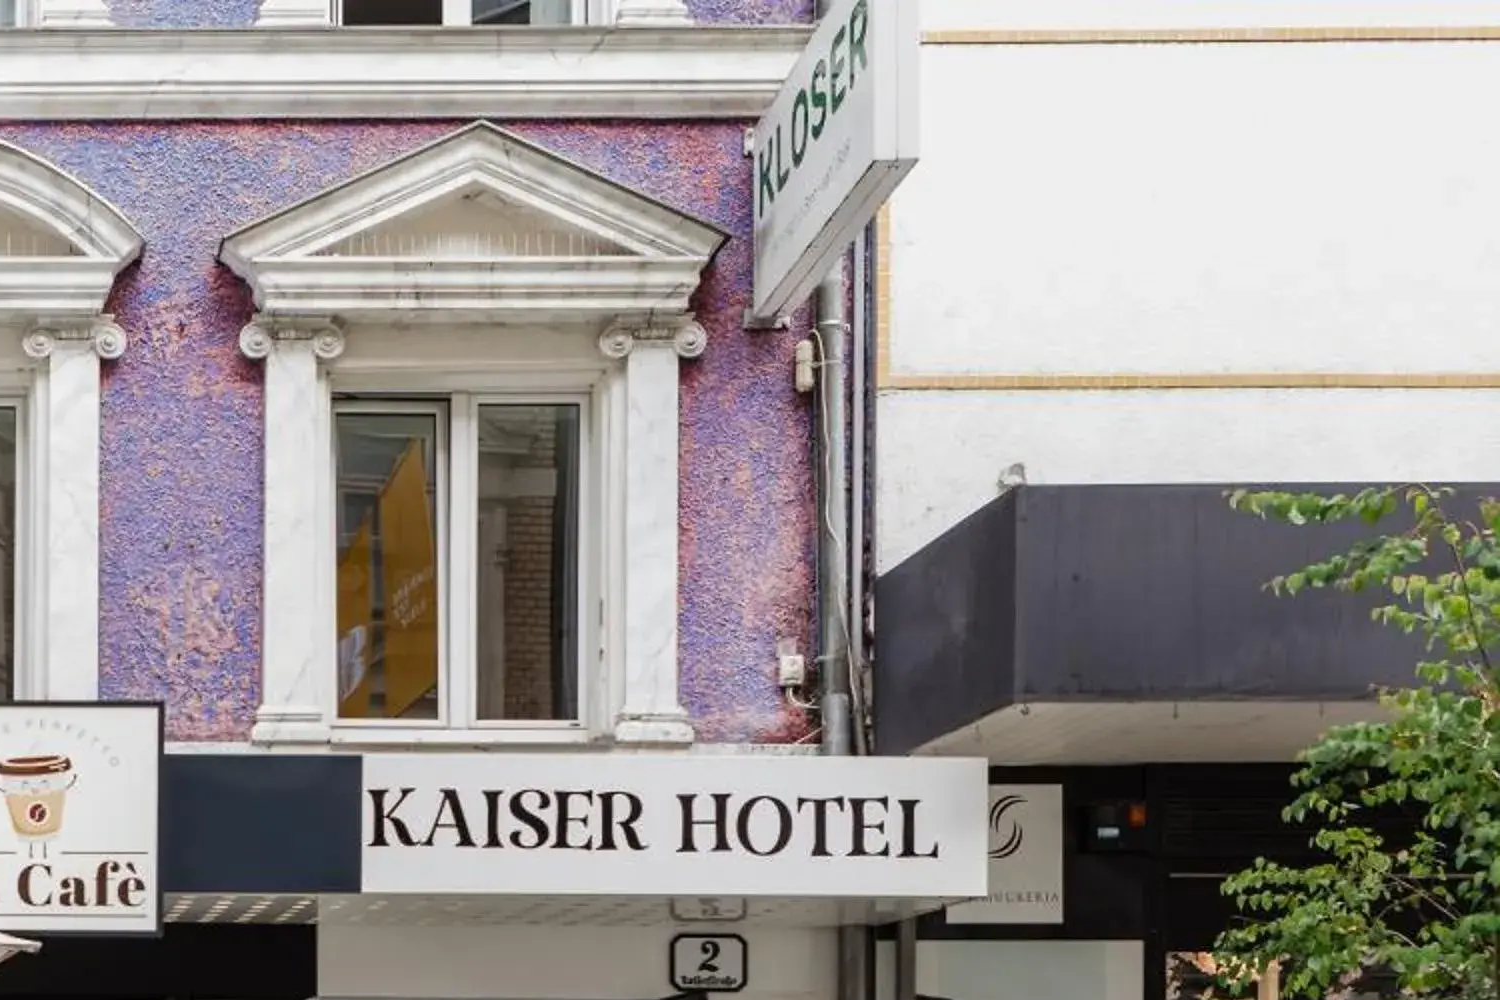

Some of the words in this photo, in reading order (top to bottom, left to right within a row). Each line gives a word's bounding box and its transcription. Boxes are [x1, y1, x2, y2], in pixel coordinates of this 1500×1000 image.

[758, 0, 869, 219] KLOSER
[366, 787, 650, 853] KAISER
[676, 792, 941, 860] HOTEL
[697, 940, 721, 973] 2
